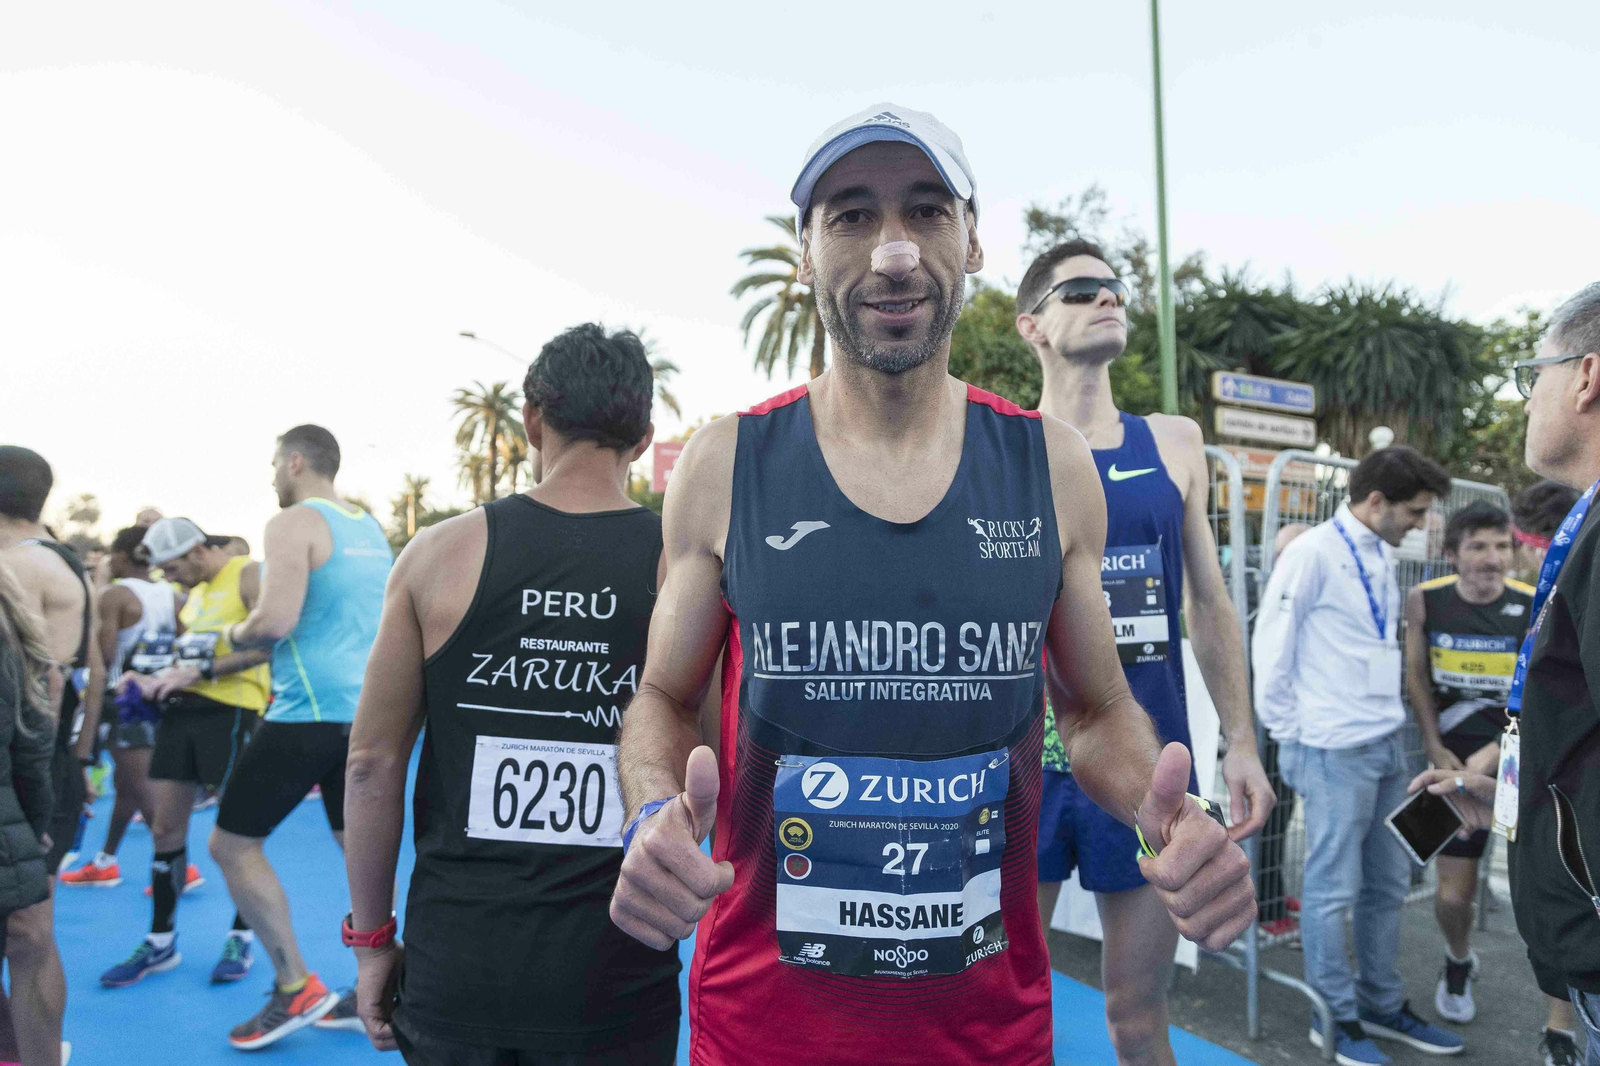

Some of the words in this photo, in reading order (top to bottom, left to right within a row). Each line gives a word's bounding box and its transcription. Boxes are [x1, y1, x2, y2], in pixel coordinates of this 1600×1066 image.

[987, 520, 1026, 538] RICKY
[979, 540, 1041, 559] SPORTEAM
[1101, 554, 1146, 571] RICH
[521, 586, 617, 620] PERÚ
[1113, 624, 1135, 638] LM
[520, 637, 610, 654] RESTAURANTE
[752, 620, 946, 673] ALEJANDRO
[958, 621, 1043, 673] SANZ
[466, 652, 637, 696] ZARUKA
[804, 681, 866, 701] SALUT
[870, 682, 993, 702] INTEGRATIVA
[501, 743, 529, 751] ZURICH
[530, 744, 565, 754] MARATÓN
[566, 747, 576, 755] DE
[578, 748, 606, 757] SEVILLA
[493, 757, 606, 835] 6230
[859, 769, 987, 804] ZURICH
[829, 820, 857, 829] ZURICH
[858, 821, 897, 830] MARATÓN
[898, 823, 908, 831] DE
[909, 822, 939, 831] SEVILLA
[940, 823, 959, 831] 2020
[976, 829, 990, 837] ELITE
[882, 842, 929, 875] 27
[839, 901, 964, 931] HASSANE
[806, 957, 830, 967] balance
[965, 940, 1003, 967] ZURICH
